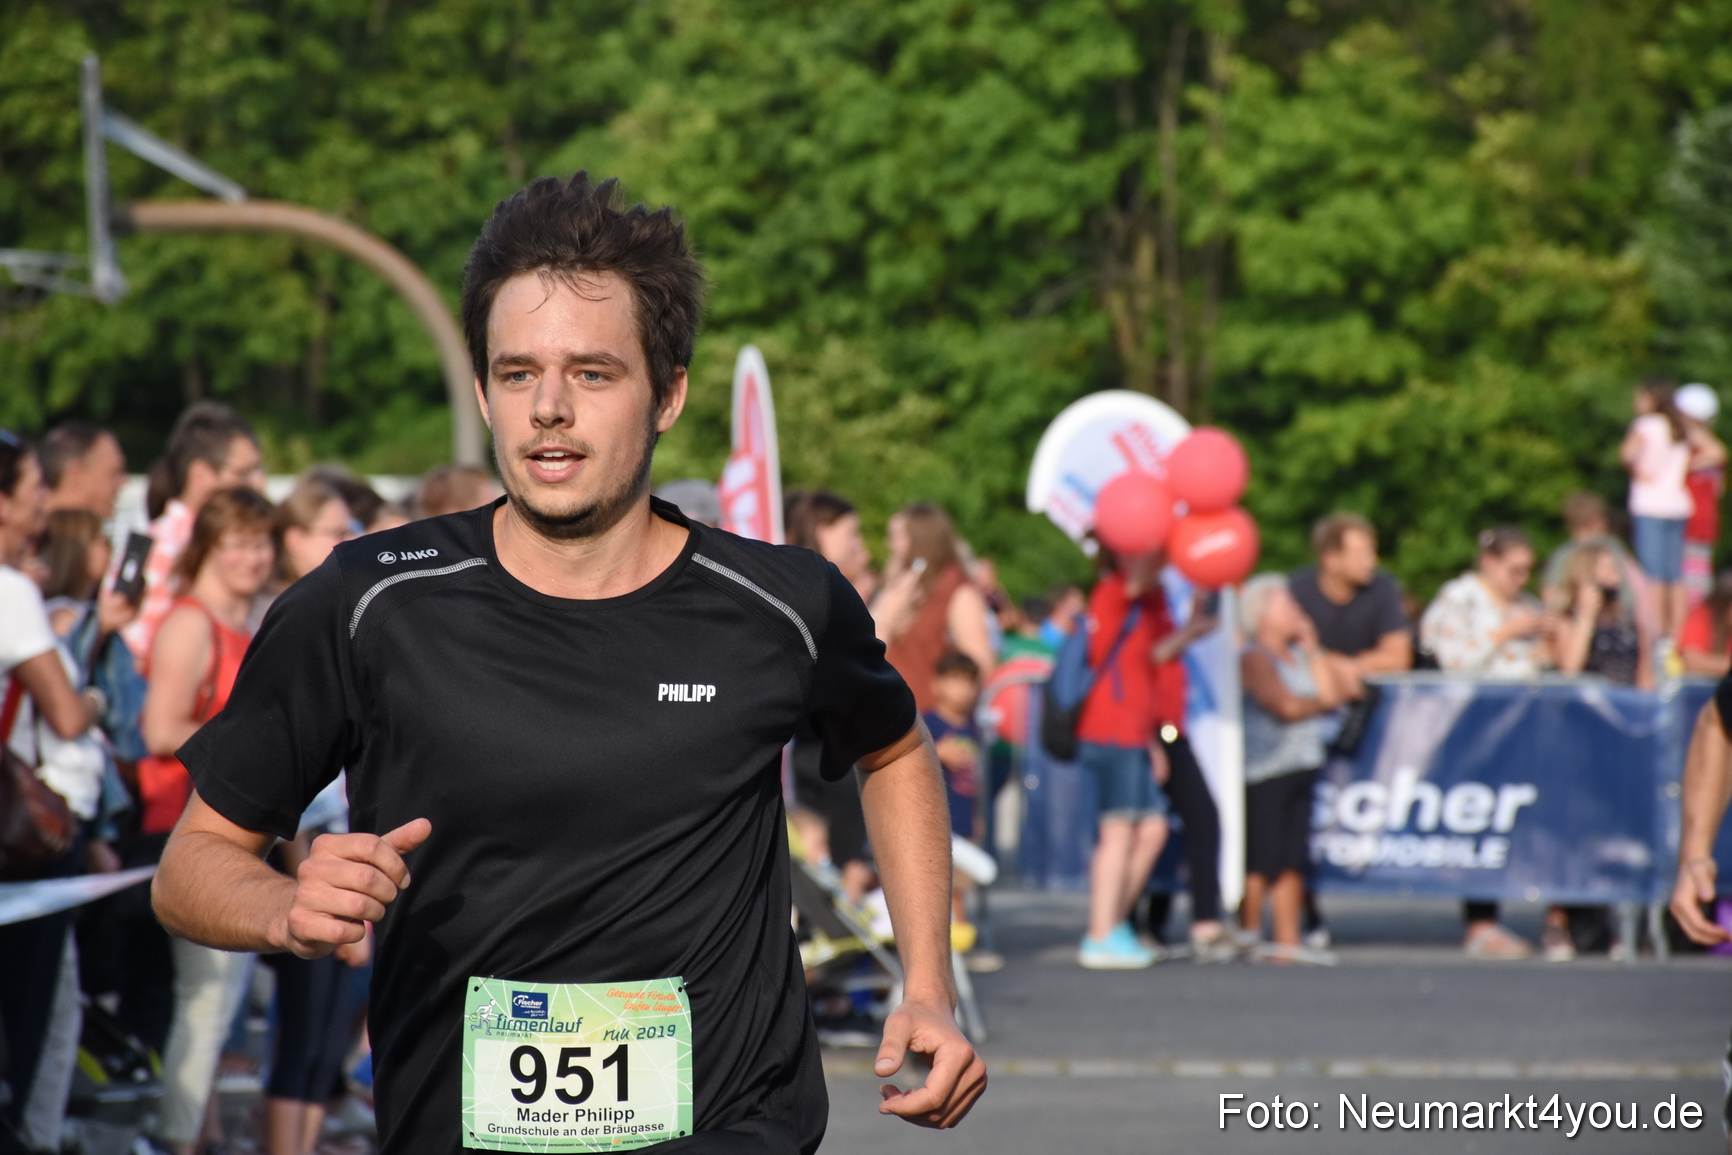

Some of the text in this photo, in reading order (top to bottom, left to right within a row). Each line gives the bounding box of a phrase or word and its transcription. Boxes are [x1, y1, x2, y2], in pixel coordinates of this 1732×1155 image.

[400, 548, 439, 561] JAKO
[658, 683, 716, 702] PHILIPP
[518, 998, 543, 1007] Fischer
[496, 1013, 583, 1033] firmenlauf
[636, 1024, 676, 1040] 2019
[509, 1044, 629, 1105] 951
[517, 1107, 635, 1124] Mader Philipp
[487, 1122, 560, 1136] Grundschule
[580, 1126, 600, 1136] der
[603, 1123, 664, 1136] Bräugasse
